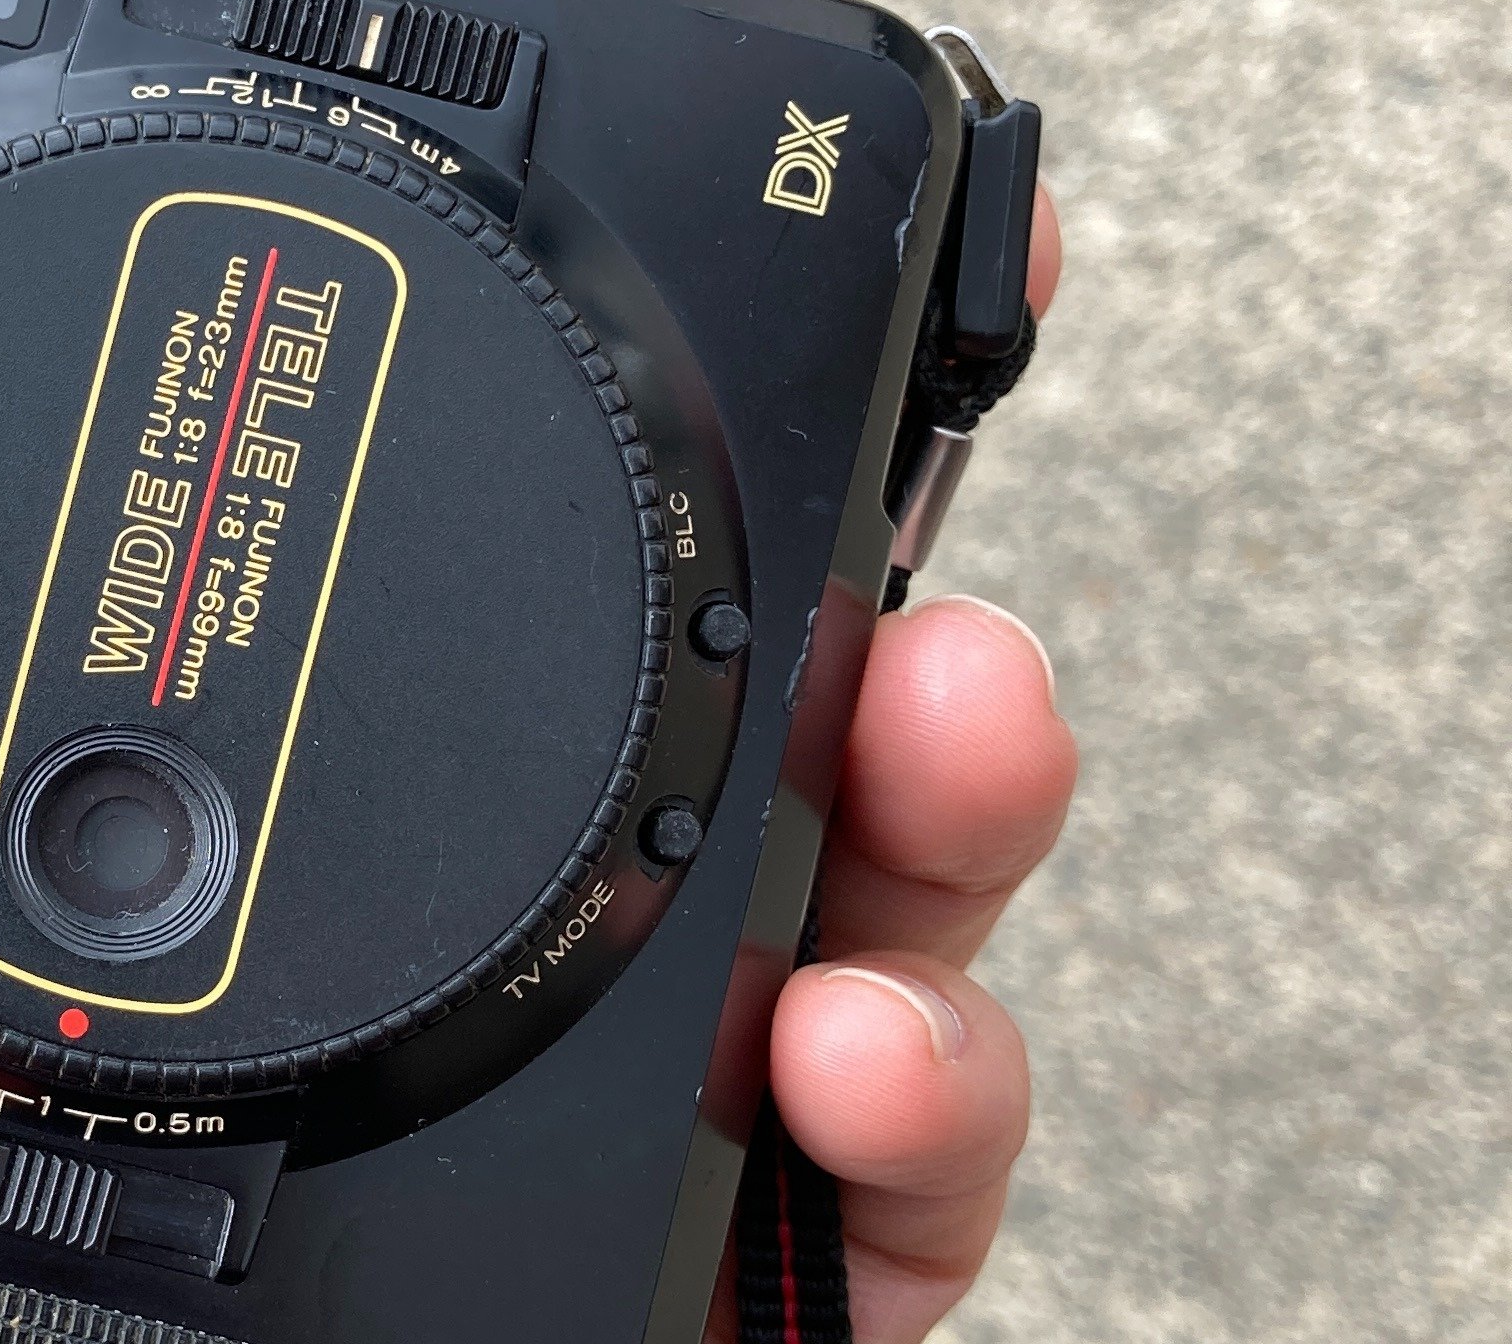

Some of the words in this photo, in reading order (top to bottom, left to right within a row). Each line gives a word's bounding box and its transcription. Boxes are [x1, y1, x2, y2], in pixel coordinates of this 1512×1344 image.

[326, 106, 350, 127] 6
[763, 100, 851, 216] DX
[139, 311, 201, 457] FUJINON
[188, 256, 249, 401] f=23mm
[232, 281, 342, 489] TELE
[174, 417, 207, 465] 1:8
[83, 470, 191, 674] WIDE
[219, 492, 252, 541] 1:8
[226, 498, 286, 647] FUJINON
[669, 491, 697, 559] BLC
[175, 557, 237, 699] f=69mm
[502, 961, 541, 999] TV
[543, 879, 615, 965] MODE
[134, 1112, 225, 1134] 0.5m
